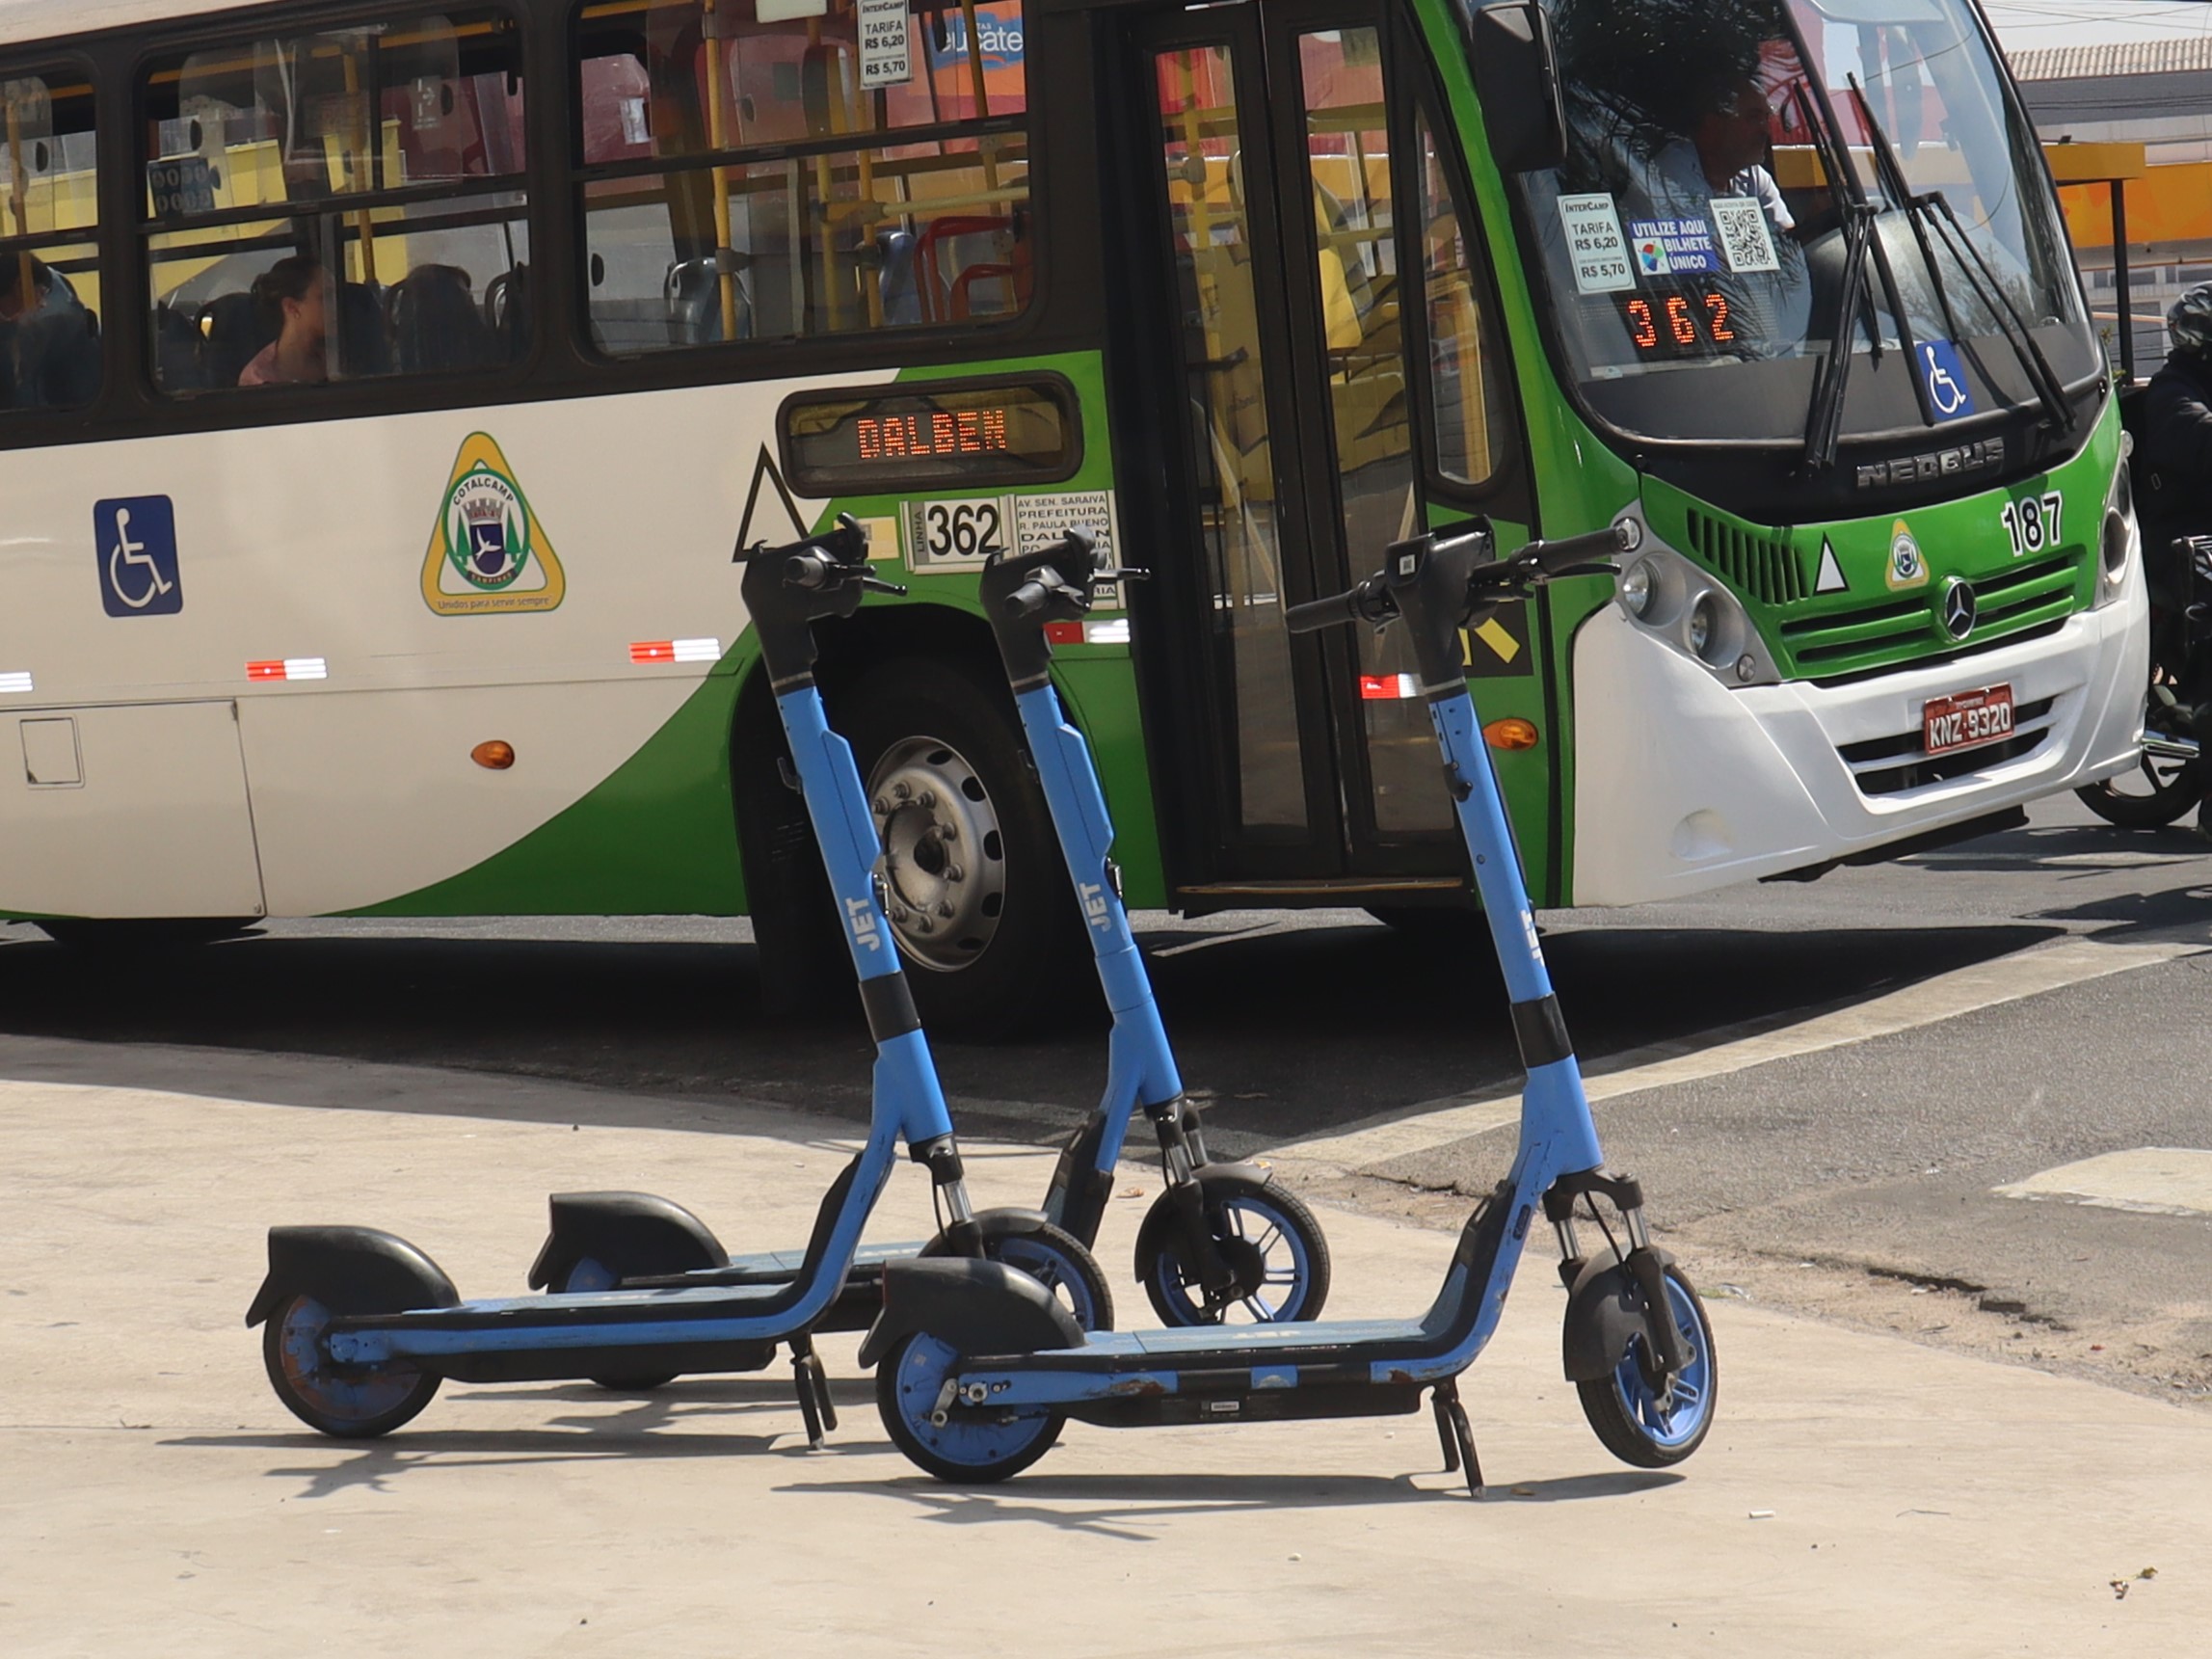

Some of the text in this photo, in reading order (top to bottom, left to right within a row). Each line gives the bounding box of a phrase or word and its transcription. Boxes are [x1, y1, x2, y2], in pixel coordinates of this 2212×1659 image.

[865, 20, 903, 35] TARIFA
[881, 35, 905, 49] 6,20
[883, 61, 906, 75] 5,70
[1572, 222, 1614, 235] TARIFA
[1632, 219, 1708, 237] UTILIZE AQUI
[1593, 236, 1618, 250] 6,20
[1663, 236, 1713, 253] BILHETE
[1668, 253, 1707, 271] ÚNICO
[1600, 263, 1626, 279] 5,70
[857, 410, 1007, 459] DALBEN
[1856, 437, 2004, 488] NEOBUS
[453, 478, 514, 505] COTALCAMP
[1061, 495, 1106, 505] SARAIVA
[1019, 507, 1107, 519] PREFEITURA
[916, 503, 1000, 556] LINHA 362
[1032, 521, 1067, 529] PAULA
[2001, 490, 2064, 557] 187
[1021, 529, 1110, 542] DALN
[470, 600, 490, 610] para
[492, 598, 516, 607] servir
[1079, 882, 1111, 933] JET
[844, 897, 880, 952] JET
